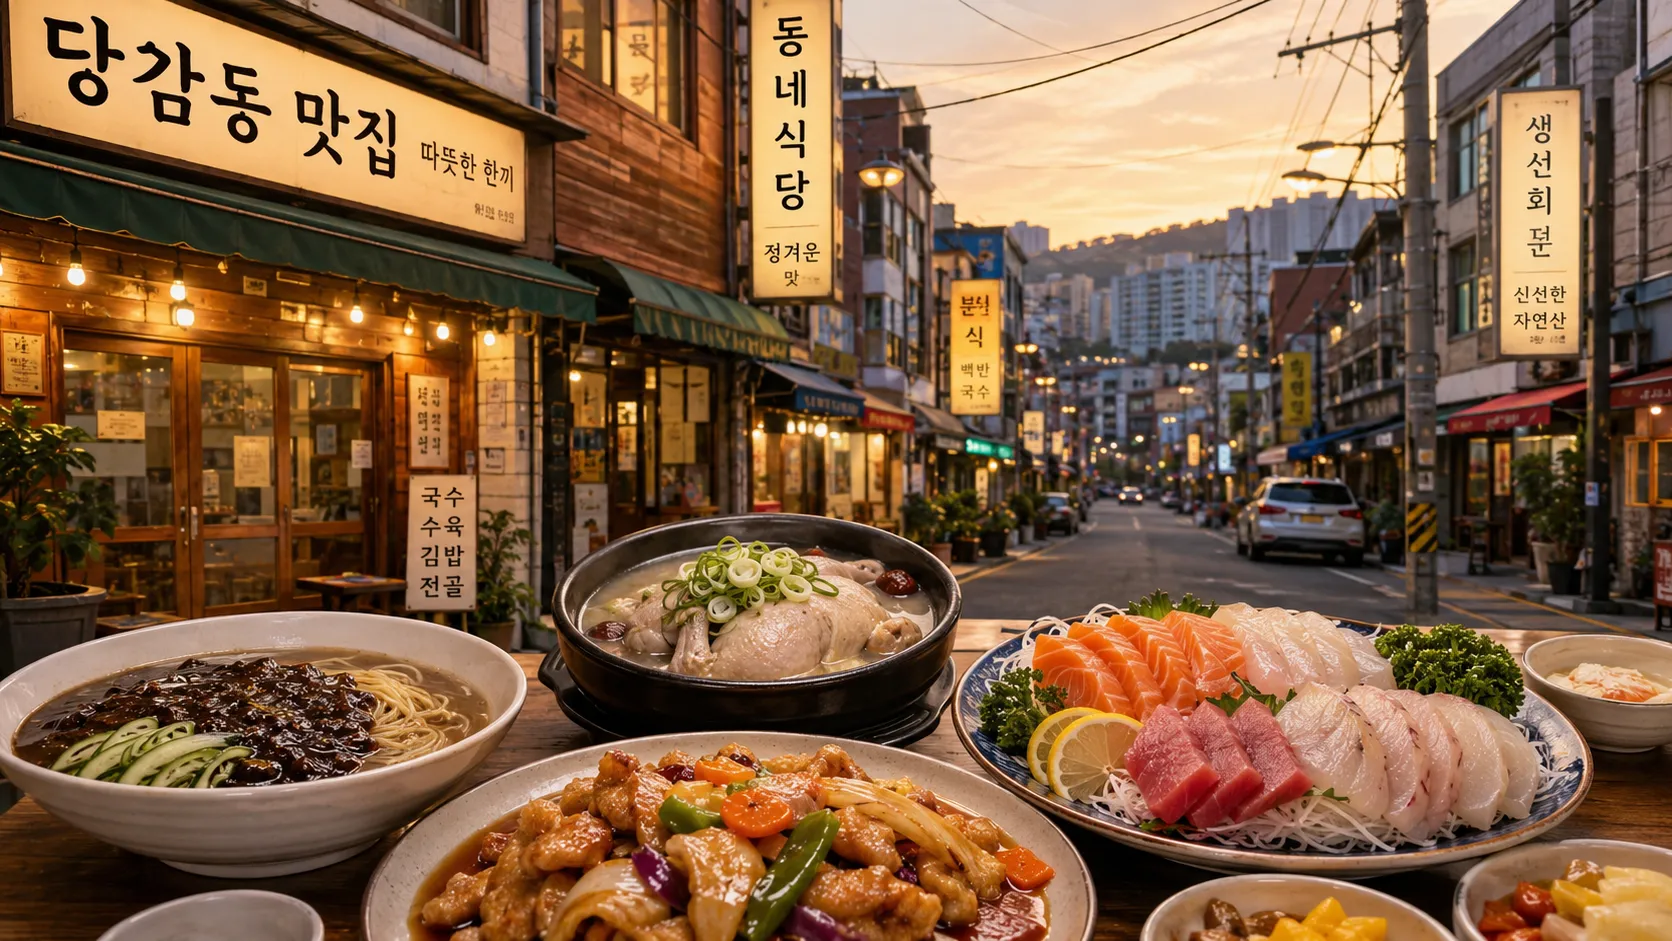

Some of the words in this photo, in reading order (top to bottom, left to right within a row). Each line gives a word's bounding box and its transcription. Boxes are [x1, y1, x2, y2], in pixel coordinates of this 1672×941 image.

[43, 15, 272, 144] 당감동
[294, 88, 396, 180] 맛집
[772, 15, 811, 211] 동네식당
[420, 140, 477, 182] 따뜻한
[483, 158, 514, 193] 한끼
[764, 242, 821, 264] 정겨운
[784, 269, 800, 287] 맛
[1513, 285, 1567, 304] 신선한
[1513, 311, 1567, 330] 자연산
[965, 325, 983, 349] 식
[960, 362, 990, 378] 백반
[960, 384, 990, 400] 국수
[421, 486, 465, 509] 국수
[420, 515, 465, 538] 수육
[420, 544, 465, 568] 김밥
[419, 575, 465, 599] 전골
